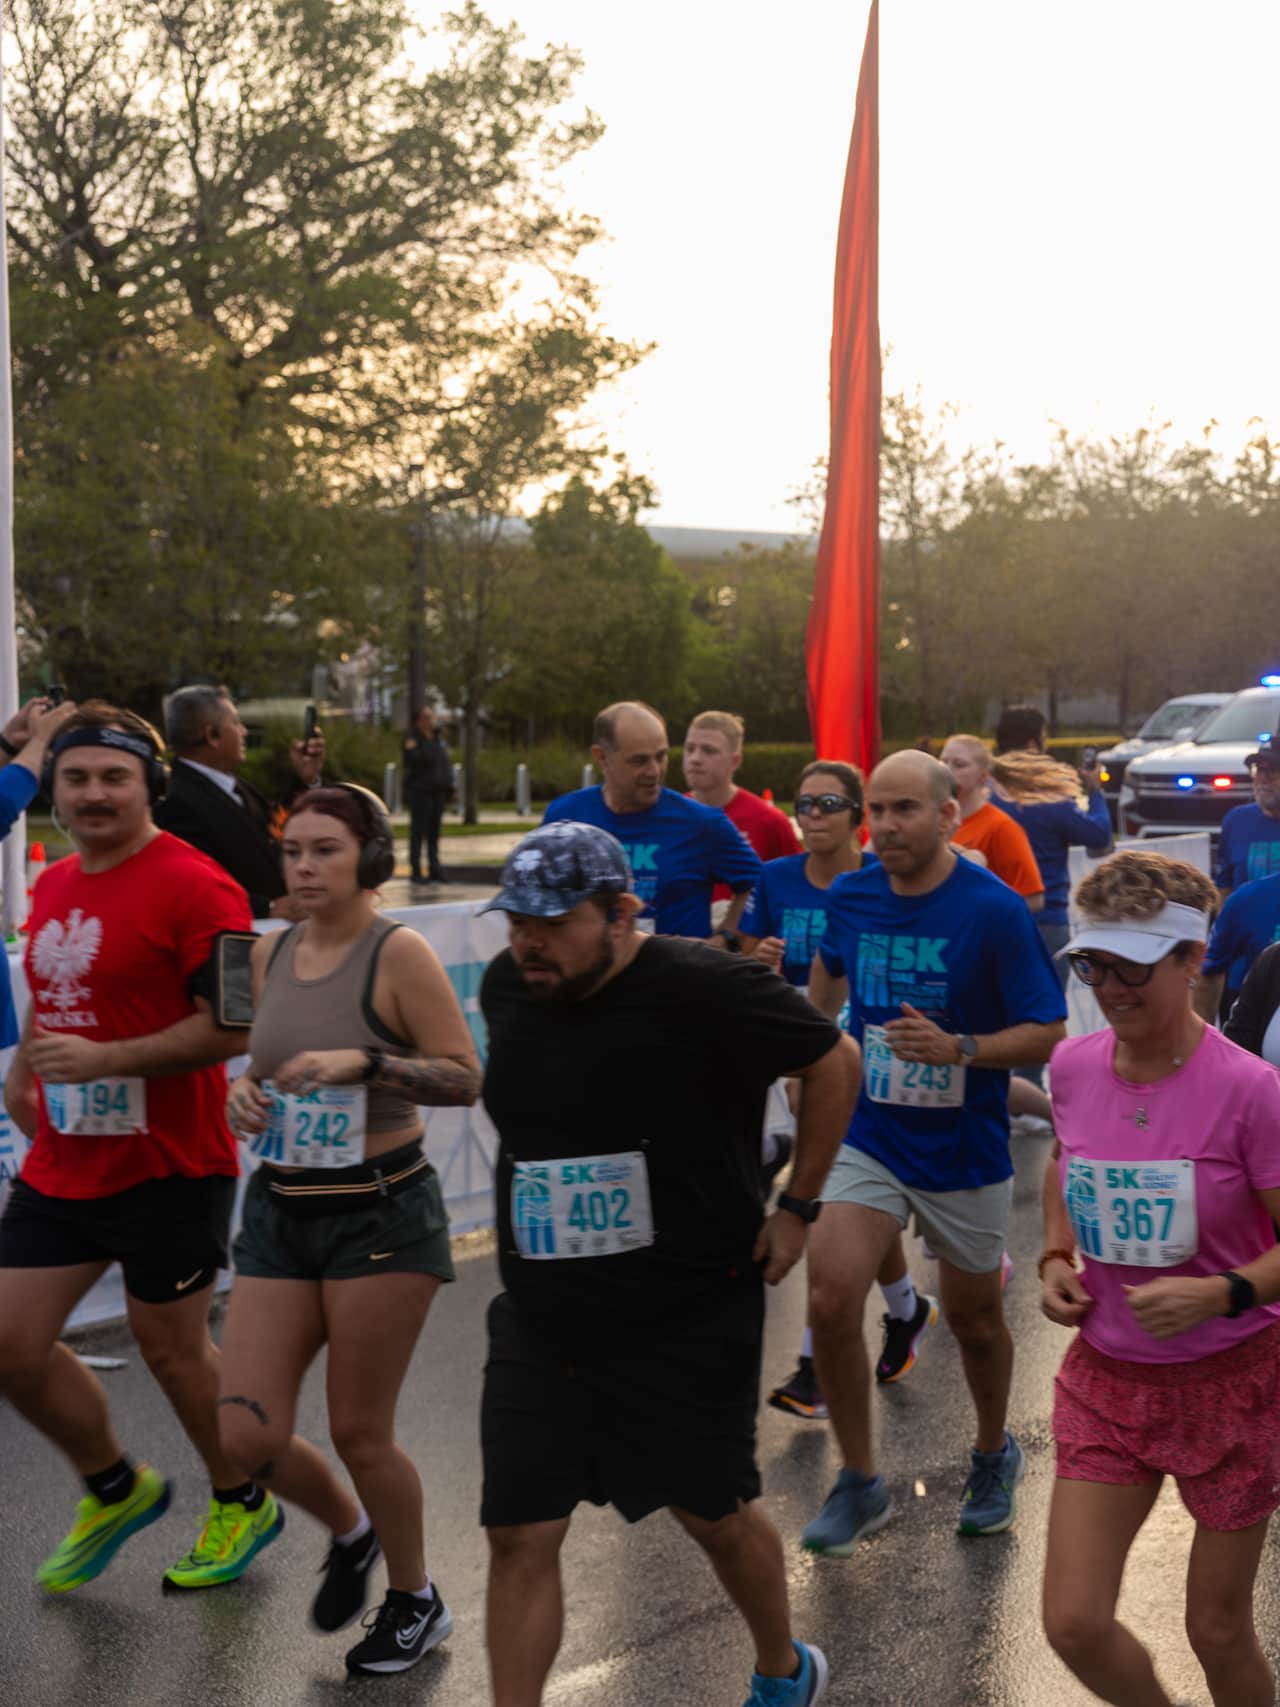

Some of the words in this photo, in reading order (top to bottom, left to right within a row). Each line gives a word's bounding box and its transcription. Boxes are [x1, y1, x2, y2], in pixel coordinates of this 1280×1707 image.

[890, 935, 950, 973] 5K
[903, 1061, 952, 1090] 243
[78, 1083, 129, 1116] 194
[294, 1110, 350, 1147] 242
[560, 1164, 595, 1185] 5K
[1106, 1168, 1141, 1189] 5K
[567, 1188, 634, 1233] 402
[1111, 1197, 1176, 1241] 367
